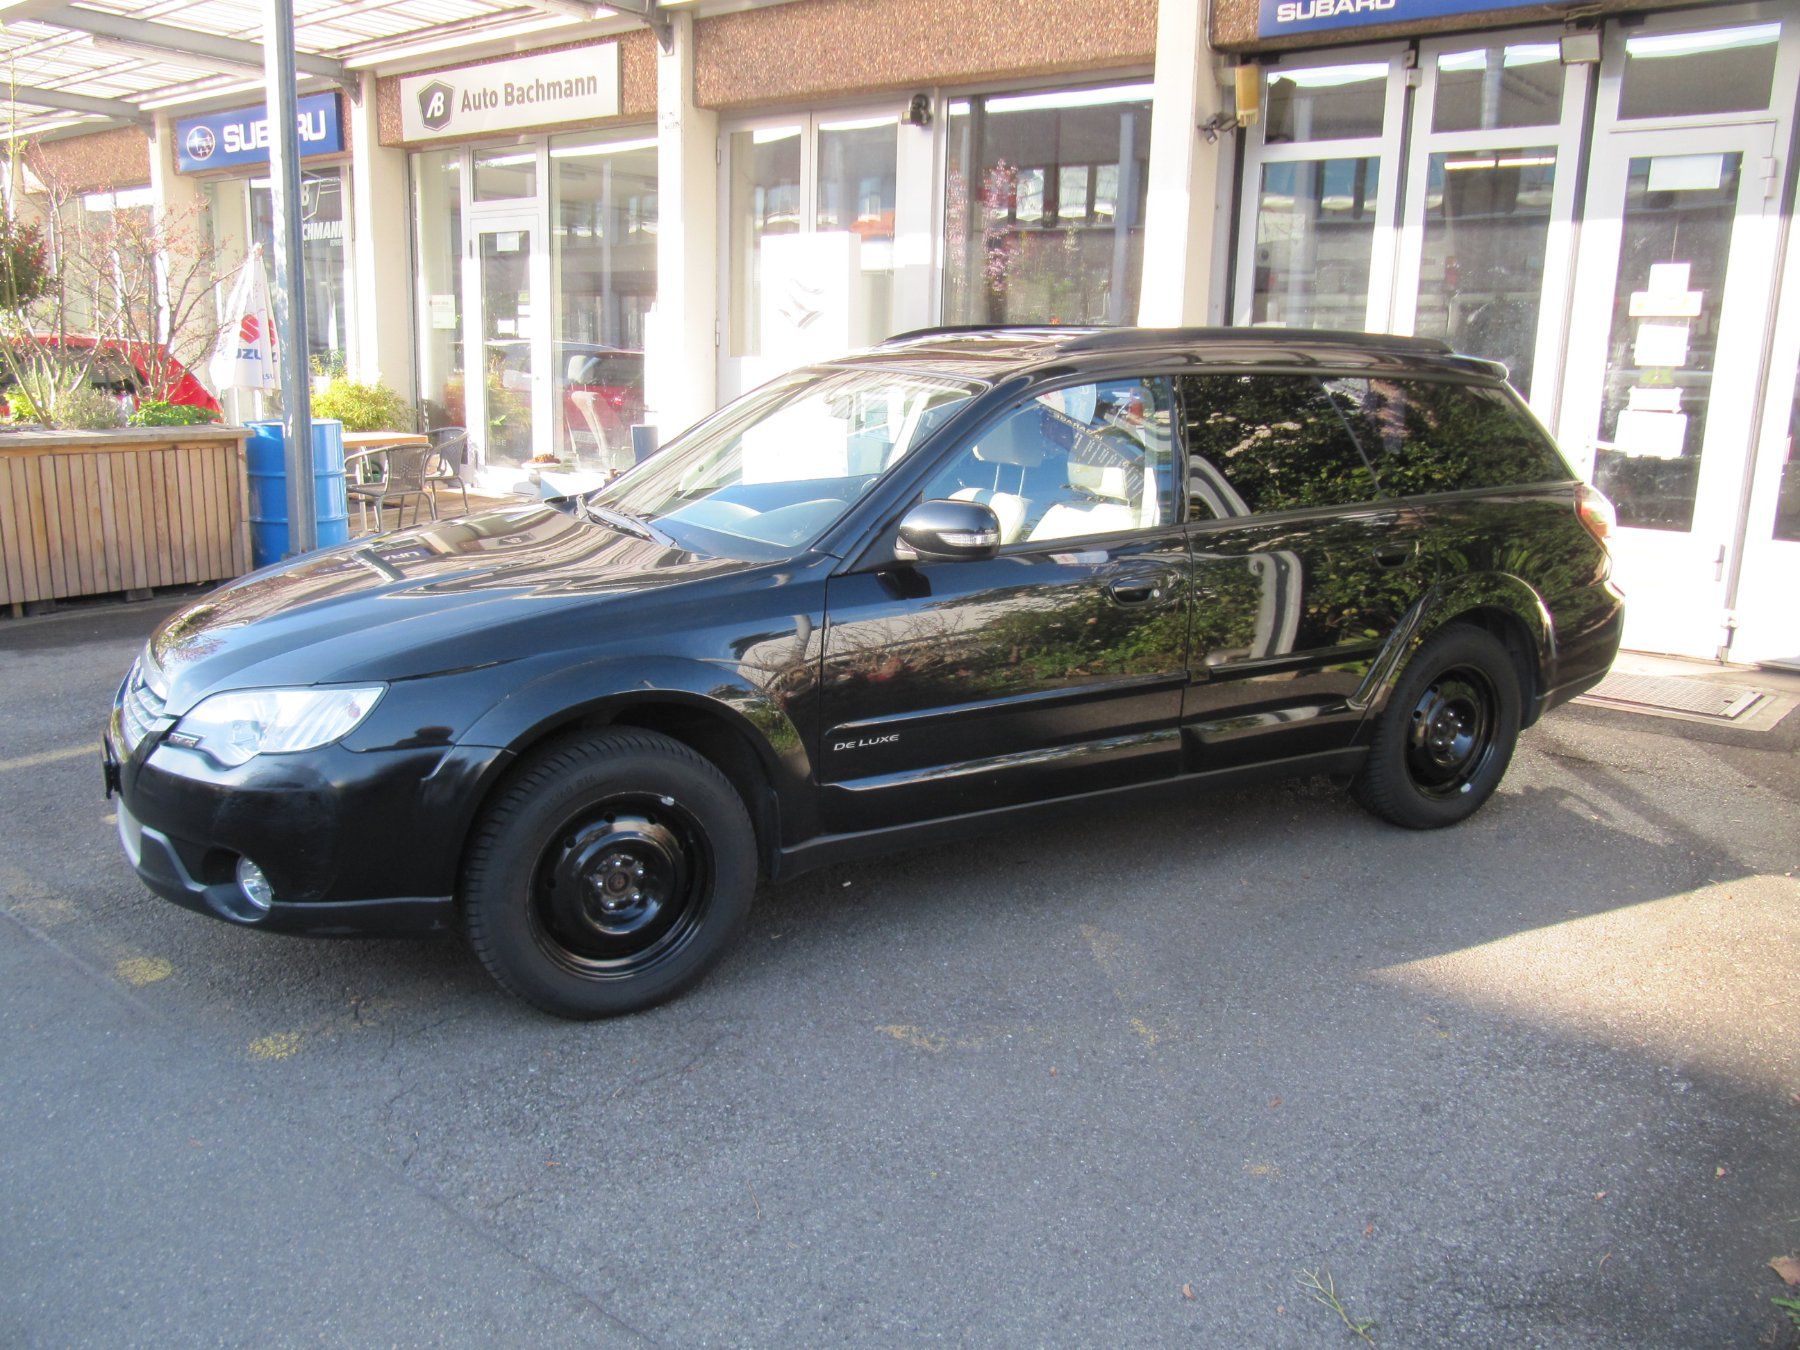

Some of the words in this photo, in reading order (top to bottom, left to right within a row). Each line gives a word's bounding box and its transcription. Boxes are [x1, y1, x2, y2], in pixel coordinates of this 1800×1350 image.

[461, 90, 499, 113] Auto
[504, 75, 598, 107] Bachmann
[223, 110, 327, 153] SUBRU
[858, 734, 900, 748] LUXE
